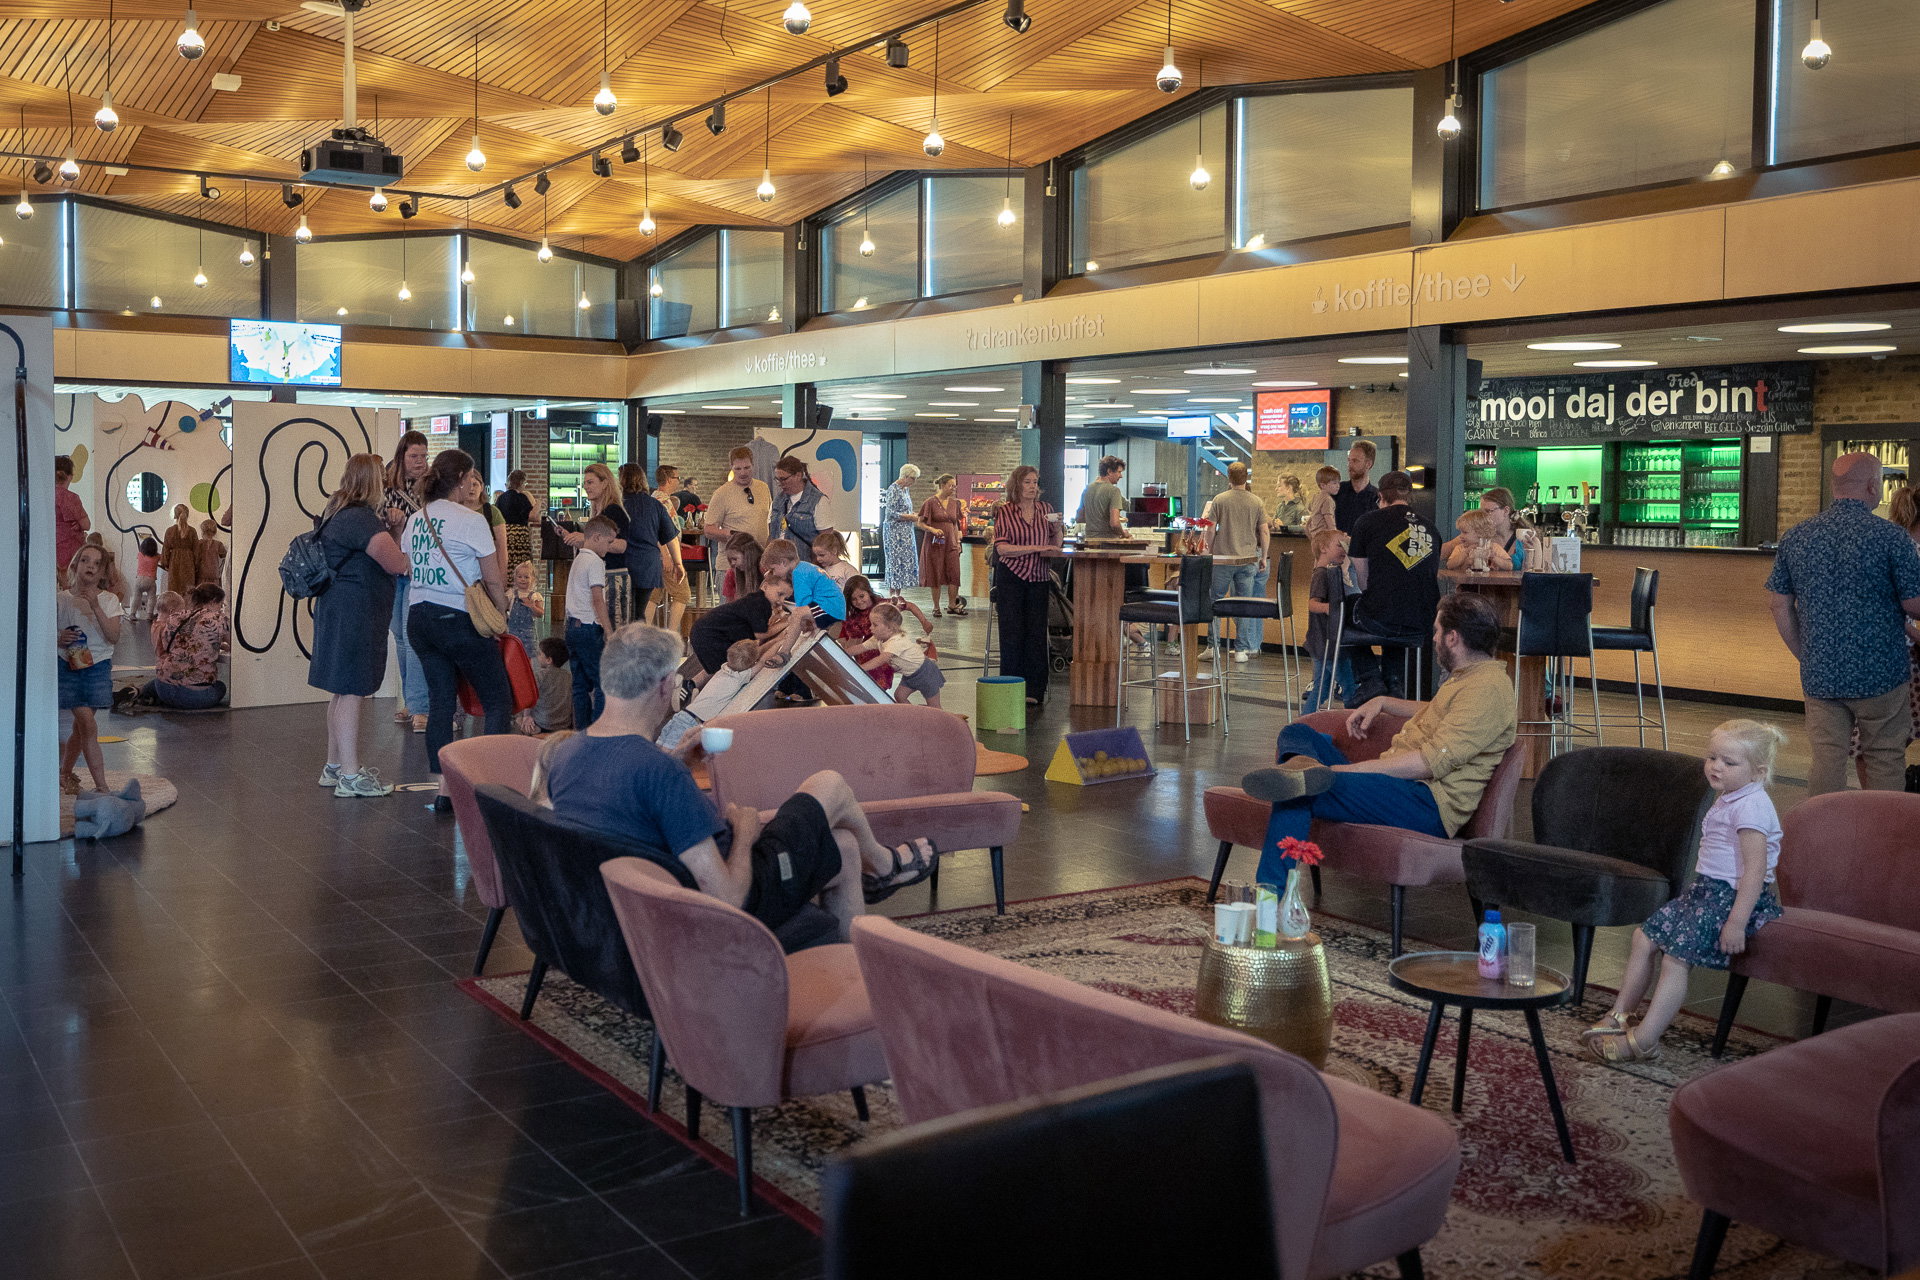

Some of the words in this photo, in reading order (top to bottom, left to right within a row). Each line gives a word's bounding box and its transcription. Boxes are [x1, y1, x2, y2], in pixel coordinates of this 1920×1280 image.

[1334, 271, 1491, 313] koffie/thee
[983, 314, 1105, 350] drankenbuffet
[755, 350, 816, 374] koffie/thee
[1667, 371, 1699, 388] Fred
[1480, 388, 1555, 421] mooi
[1566, 384, 1615, 425] daj
[1626, 383, 1684, 416] der
[1696, 379, 1768, 414] bint
[412, 517, 446, 536] MORE
[412, 533, 443, 551] AMOR
[412, 566, 449, 586] AVOR
